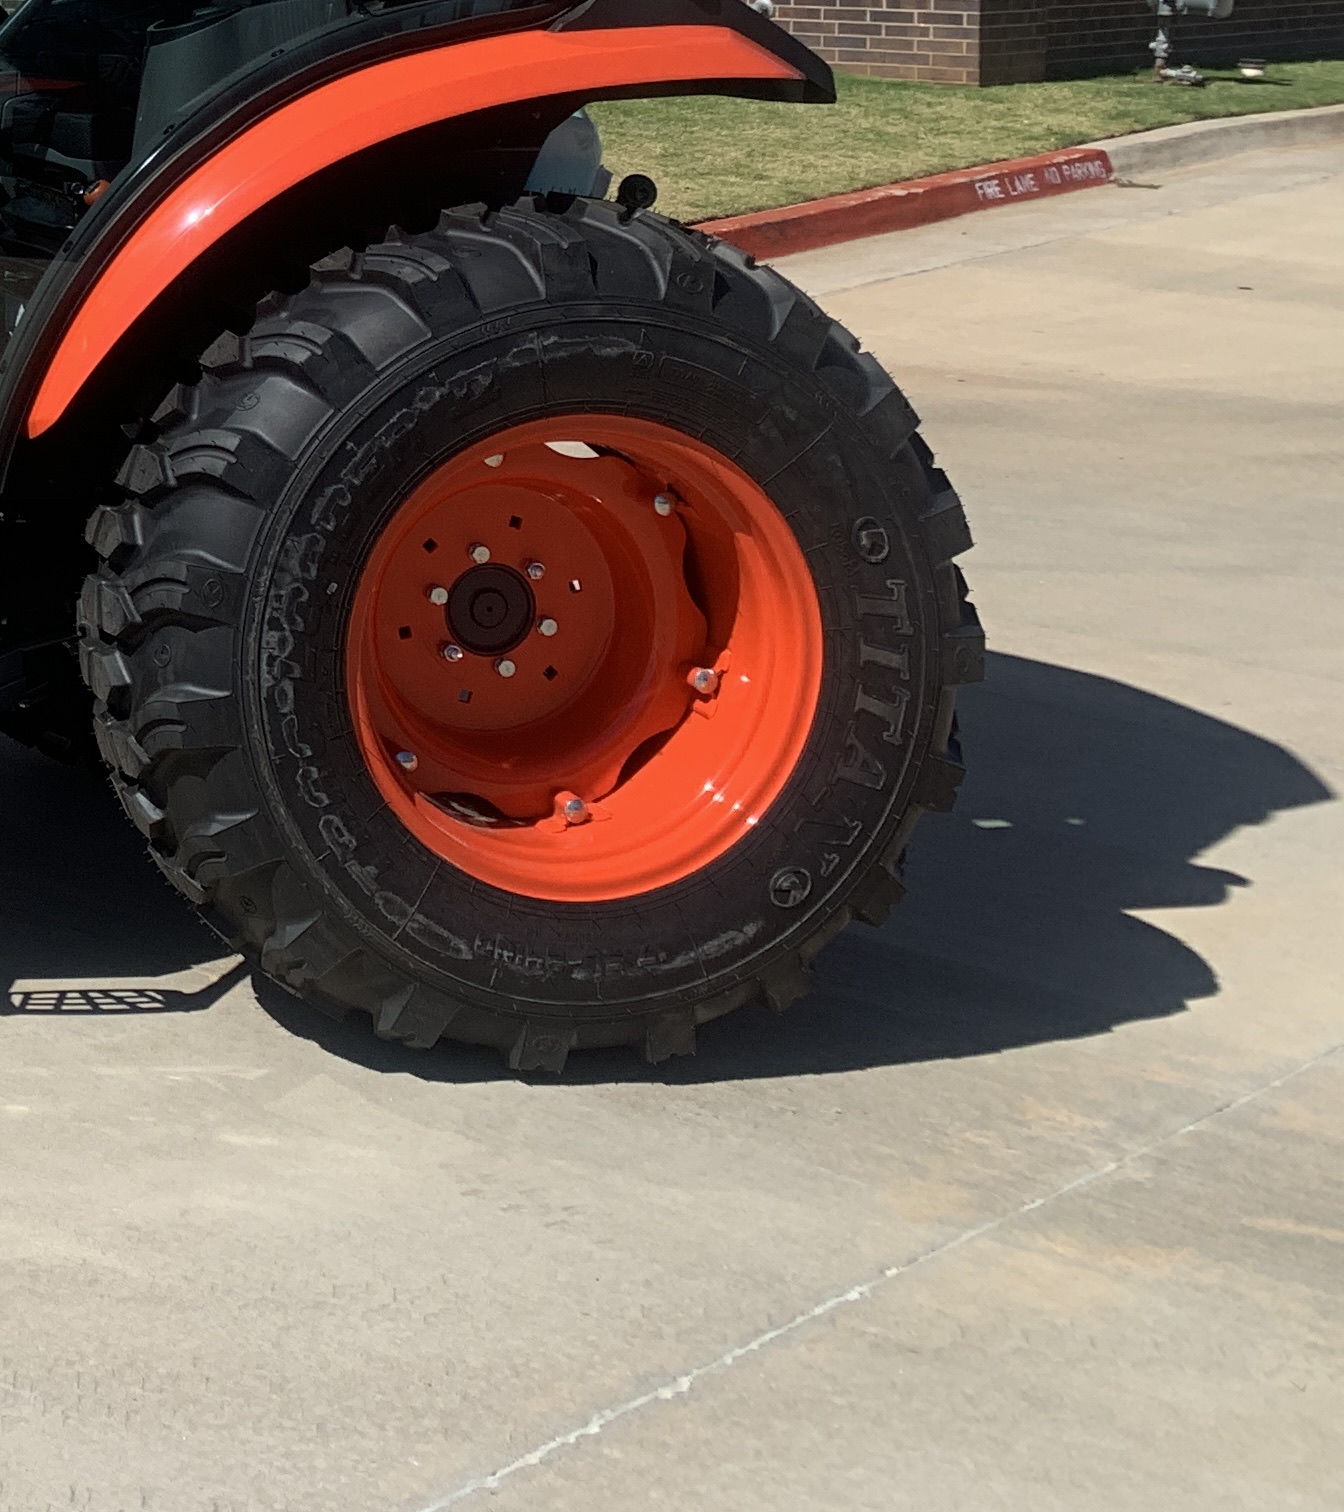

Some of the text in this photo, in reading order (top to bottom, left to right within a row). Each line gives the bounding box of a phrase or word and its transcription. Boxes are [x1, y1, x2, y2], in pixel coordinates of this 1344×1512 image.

[975, 160, 1108, 201] FIRE LANE NO PARKING
